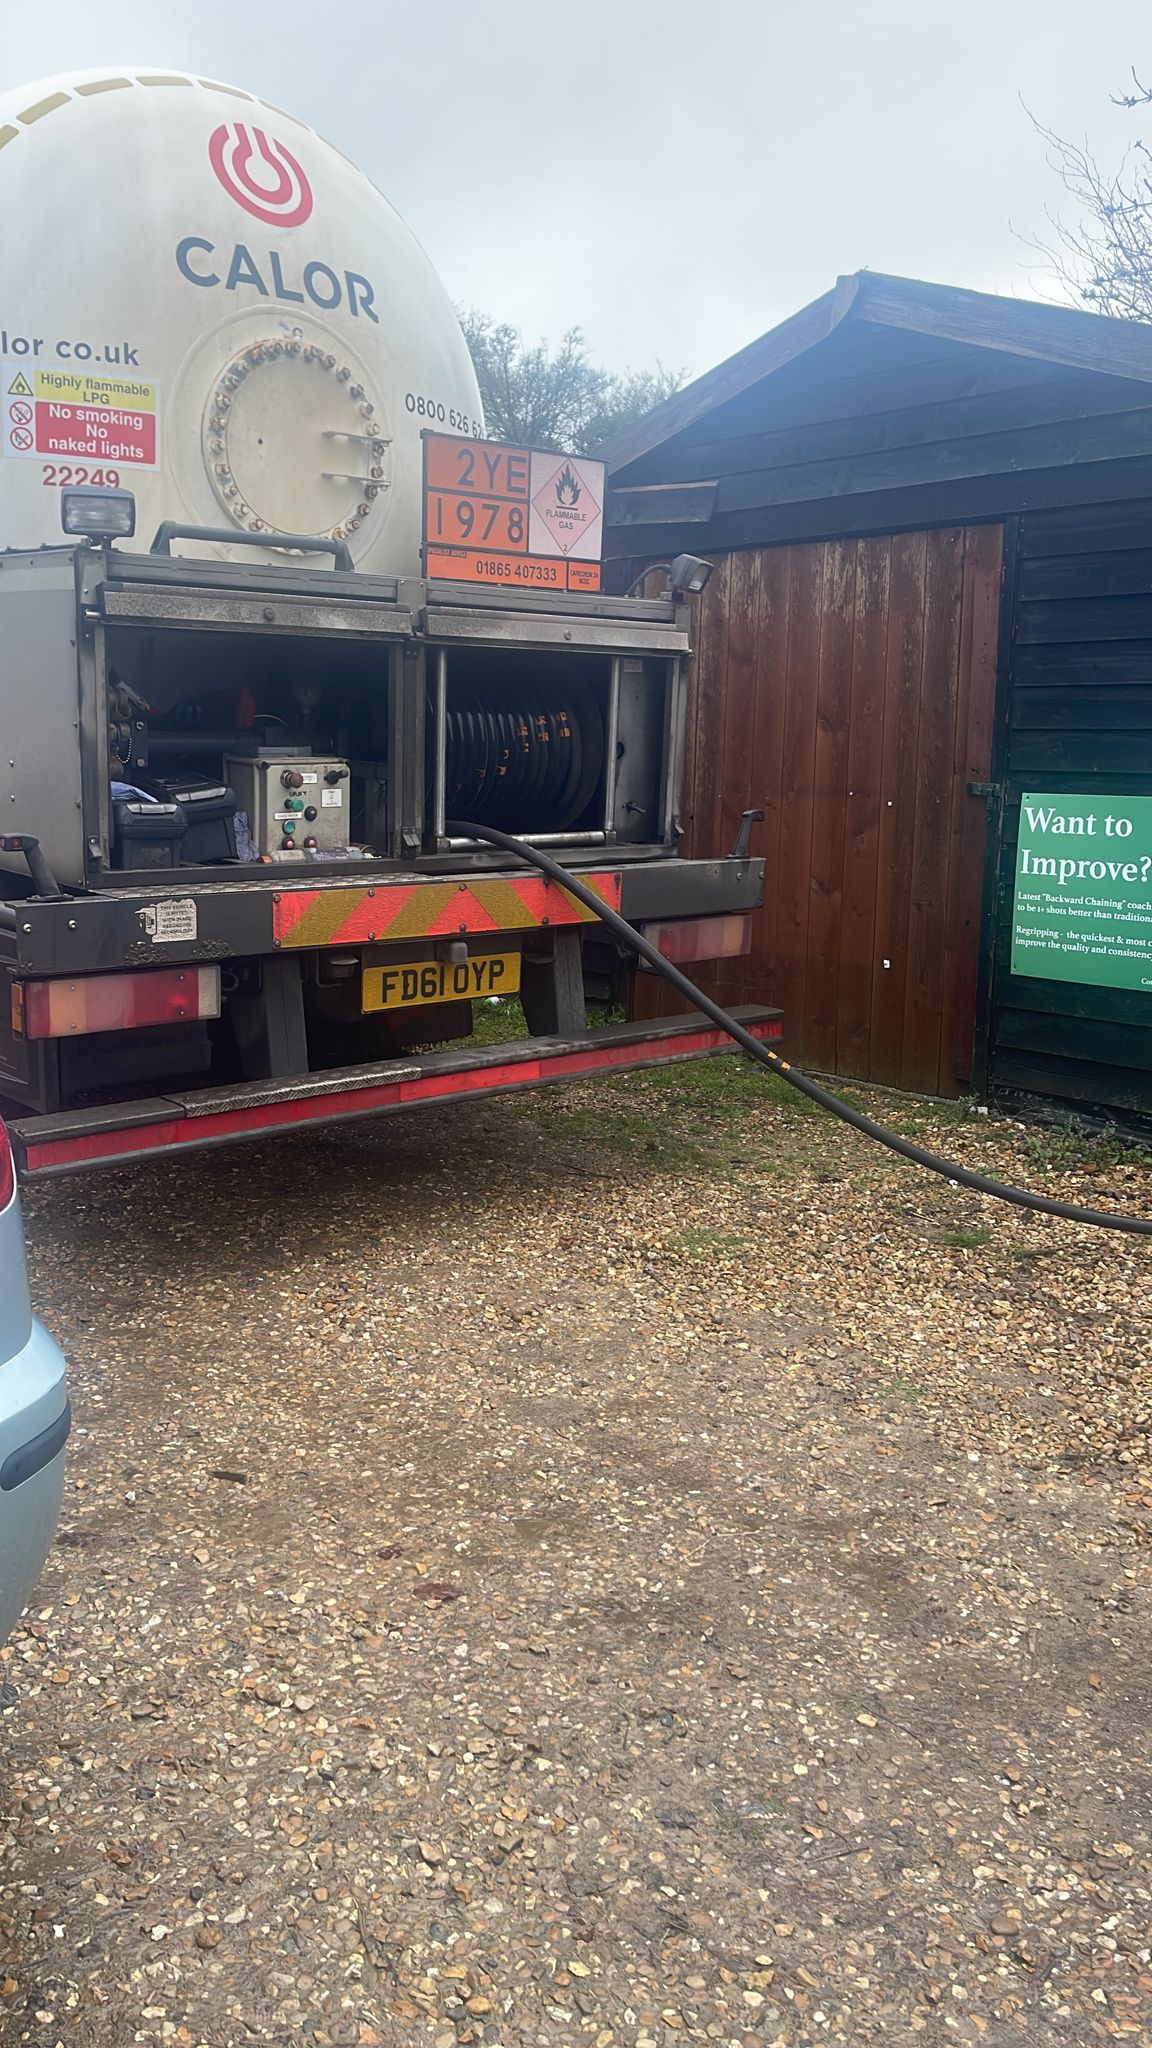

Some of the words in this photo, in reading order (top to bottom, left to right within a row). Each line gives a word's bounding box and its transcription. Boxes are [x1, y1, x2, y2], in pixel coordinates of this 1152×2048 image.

[175, 236, 380, 324] CALOR
[56, 340, 140, 366] co.uk
[41, 373, 82, 390] Highly
[86, 378, 150, 396] flammable
[83, 392, 110, 405] LPG
[49, 404, 71, 419] No
[76, 411, 143, 430] smoking
[405, 392, 445, 422] 0800
[449, 408, 469, 433] 626
[86, 423, 108, 439] No
[48, 437, 97, 453] naked
[101, 441, 144, 458] lights
[42, 464, 120, 488] 22249
[457, 447, 528, 494] 2YE
[436, 497, 524, 544] 1978
[545, 509, 587, 522] FLAMMABLE
[558, 521, 574, 530] GAS
[563, 544, 568, 552] 2
[476, 560, 511, 577] 01865
[515, 564, 557, 582] 407333
[1024, 806, 1097, 836] Want
[1104, 813, 1133, 837] to
[1020, 848, 1152, 886] Improve?
[1018, 891, 1041, 901] Latest
[1042, 893, 1084, 905] "Backward
[1085, 896, 1127, 910] Chaining"
[1026, 903, 1036, 912] be
[1046, 905, 1067, 915] shots
[1068, 907, 1092, 917] better
[1093, 909, 1112, 919] than
[1015, 936, 1047, 948] improve
[1048, 940, 1061, 949] the
[1061, 942, 1090, 954] quality
[1091, 946, 1106, 954] and
[1016, 925, 1060, 940] Regripping
[1066, 930, 1080, 940] the
[1080, 933, 1115, 943] quickest
[1116, 935, 1124, 944] &
[1126, 938, 1146, 947] most
[381, 965, 445, 1004] FD61
[453, 959, 505, 994] OYP
